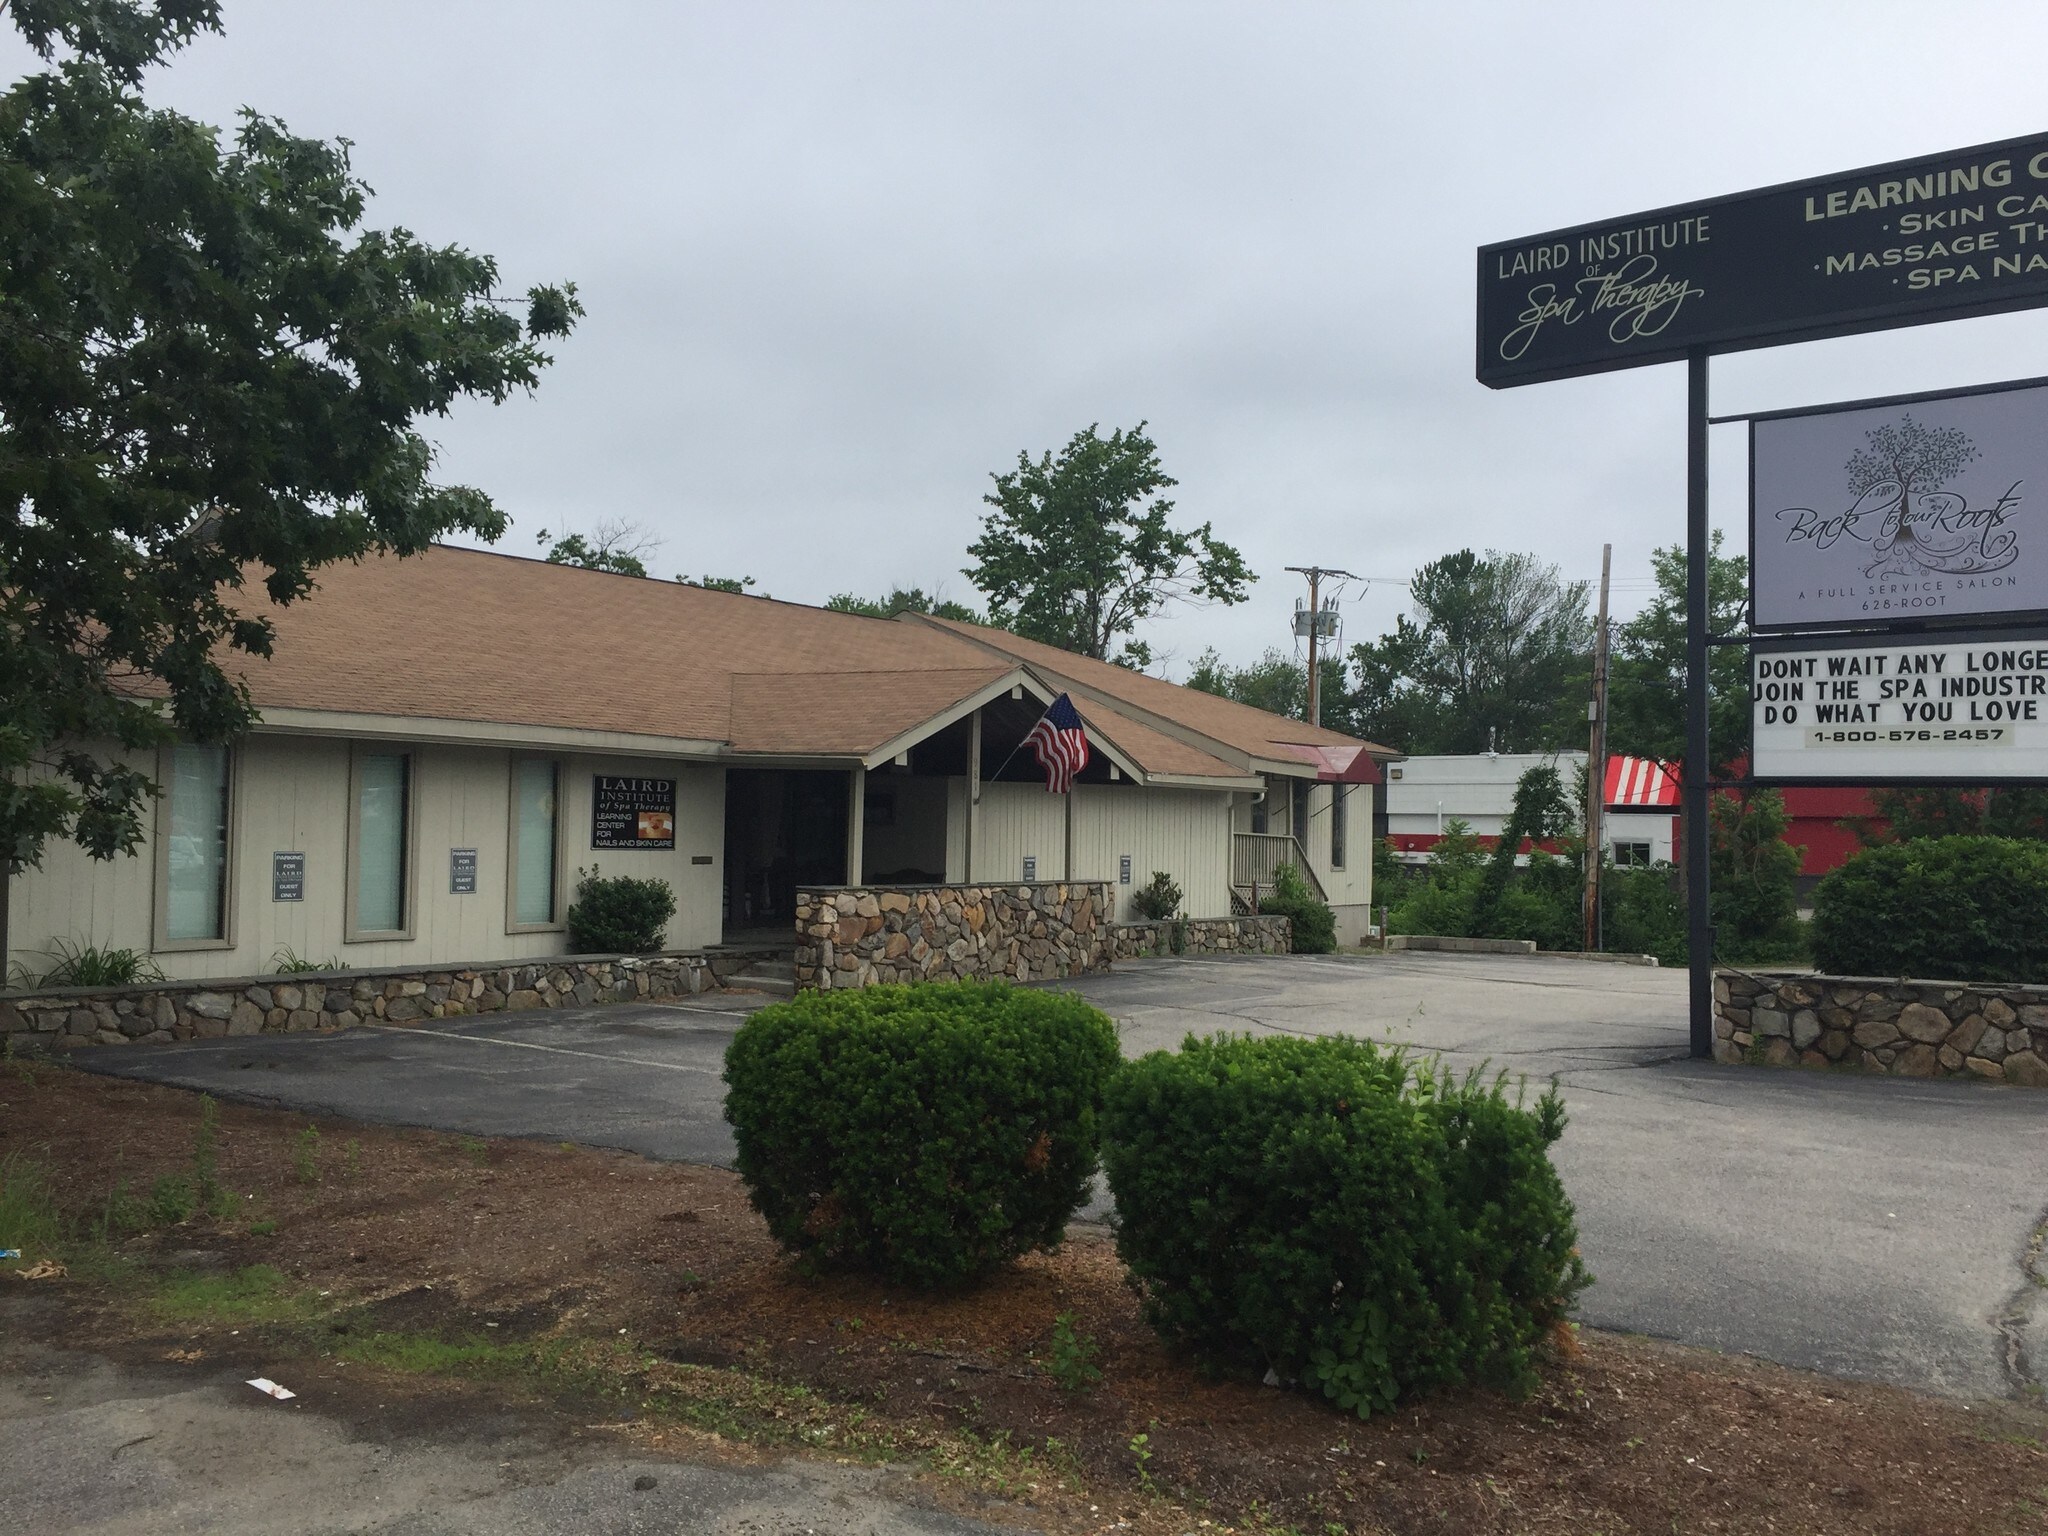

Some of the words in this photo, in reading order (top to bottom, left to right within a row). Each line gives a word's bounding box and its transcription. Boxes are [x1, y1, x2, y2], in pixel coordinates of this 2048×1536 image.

[1805, 159, 2012, 222] LEARNING
[1899, 205, 1984, 235] SKIN
[1996, 194, 2048, 218] CA
[1499, 244, 1570, 279] LAIRD
[1579, 215, 1710, 264] INSTITUTE
[1826, 231, 2000, 275] MASSAGE
[1585, 264, 1601, 278] OF
[1907, 264, 1981, 289] SPA
[1993, 253, 2048, 278] NA
[1500, 283, 1584, 361] Spa
[1575, 254, 1705, 343] Therapy
[1775, 479, 1904, 550] Back
[1880, 502, 1902, 538] to
[1903, 511, 1936, 525] our
[1918, 480, 2024, 560] Roots
[1798, 591, 1806, 600] A
[1818, 588, 1856, 598] FULL
[1868, 581, 1944, 596] SERVICE
[1956, 576, 2017, 589] SALON
[1862, 595, 1947, 611] 628-ROOT
[1759, 658, 1818, 679] DONT
[1827, 655, 1888, 676] WAIT
[1899, 653, 1946, 675] ANY
[1967, 650, 2048, 672] LONGE
[1754, 682, 1804, 701] JOIN
[1816, 681, 1859, 700] THE
[1880, 678, 1928, 699] SPA
[1941, 675, 2047, 698] INDUSTR
[1764, 704, 1798, 725] DO
[1816, 703, 1881, 723] WHAT
[1902, 701, 1952, 722] YOU
[1970, 700, 2038, 721] LOVE
[1814, 729, 2004, 743] 1-800-576-2457
[600, 791, 670, 802] INSTITUTE
[601, 778, 670, 792] LAIRD
[596, 812, 632, 821] LEARNING
[600, 802, 611, 810] of
[613, 801, 631, 811] Spa
[634, 802, 671, 812] Therapy
[596, 821, 625, 829] CENTER
[596, 830, 612, 838] FOR
[596, 839, 618, 847] NAILS
[619, 839, 636, 847] AND
[636, 839, 653, 847] SKIN
